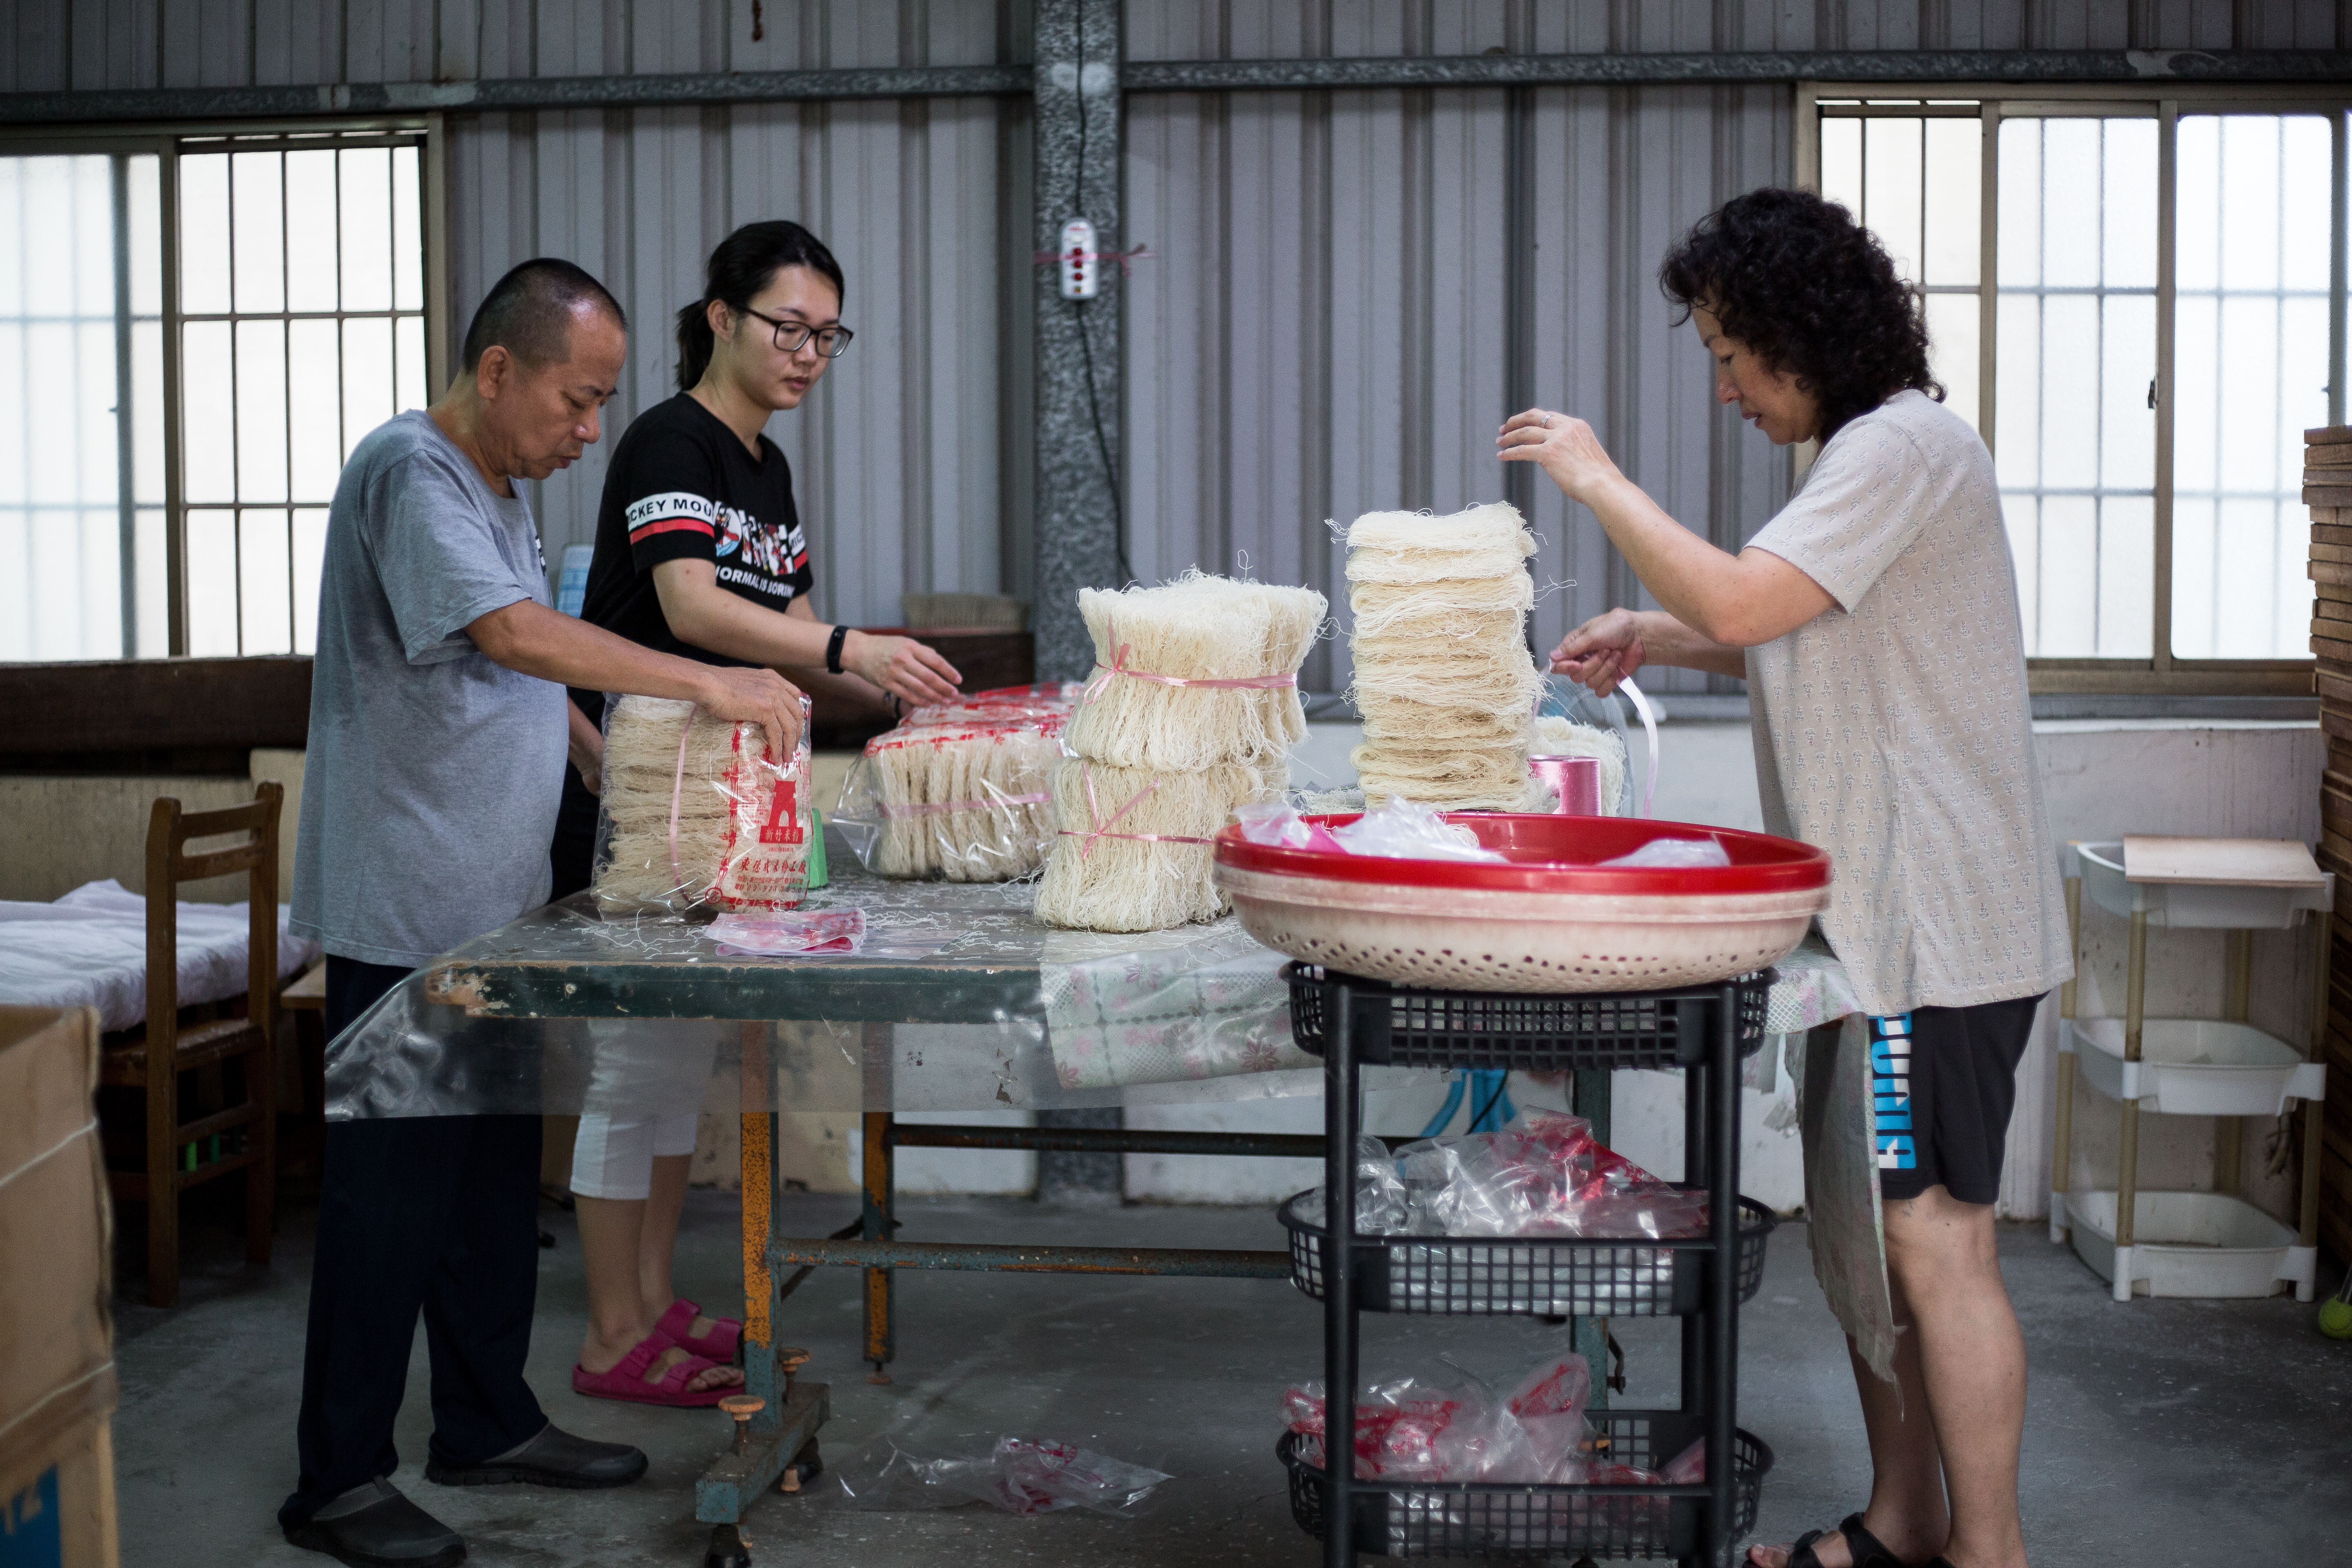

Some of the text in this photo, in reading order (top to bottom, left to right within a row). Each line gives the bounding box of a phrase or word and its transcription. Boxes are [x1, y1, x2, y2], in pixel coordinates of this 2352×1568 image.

[765, 828, 800, 842] 新竹米粉
[1868, 1011, 1917, 1169] PUMA
